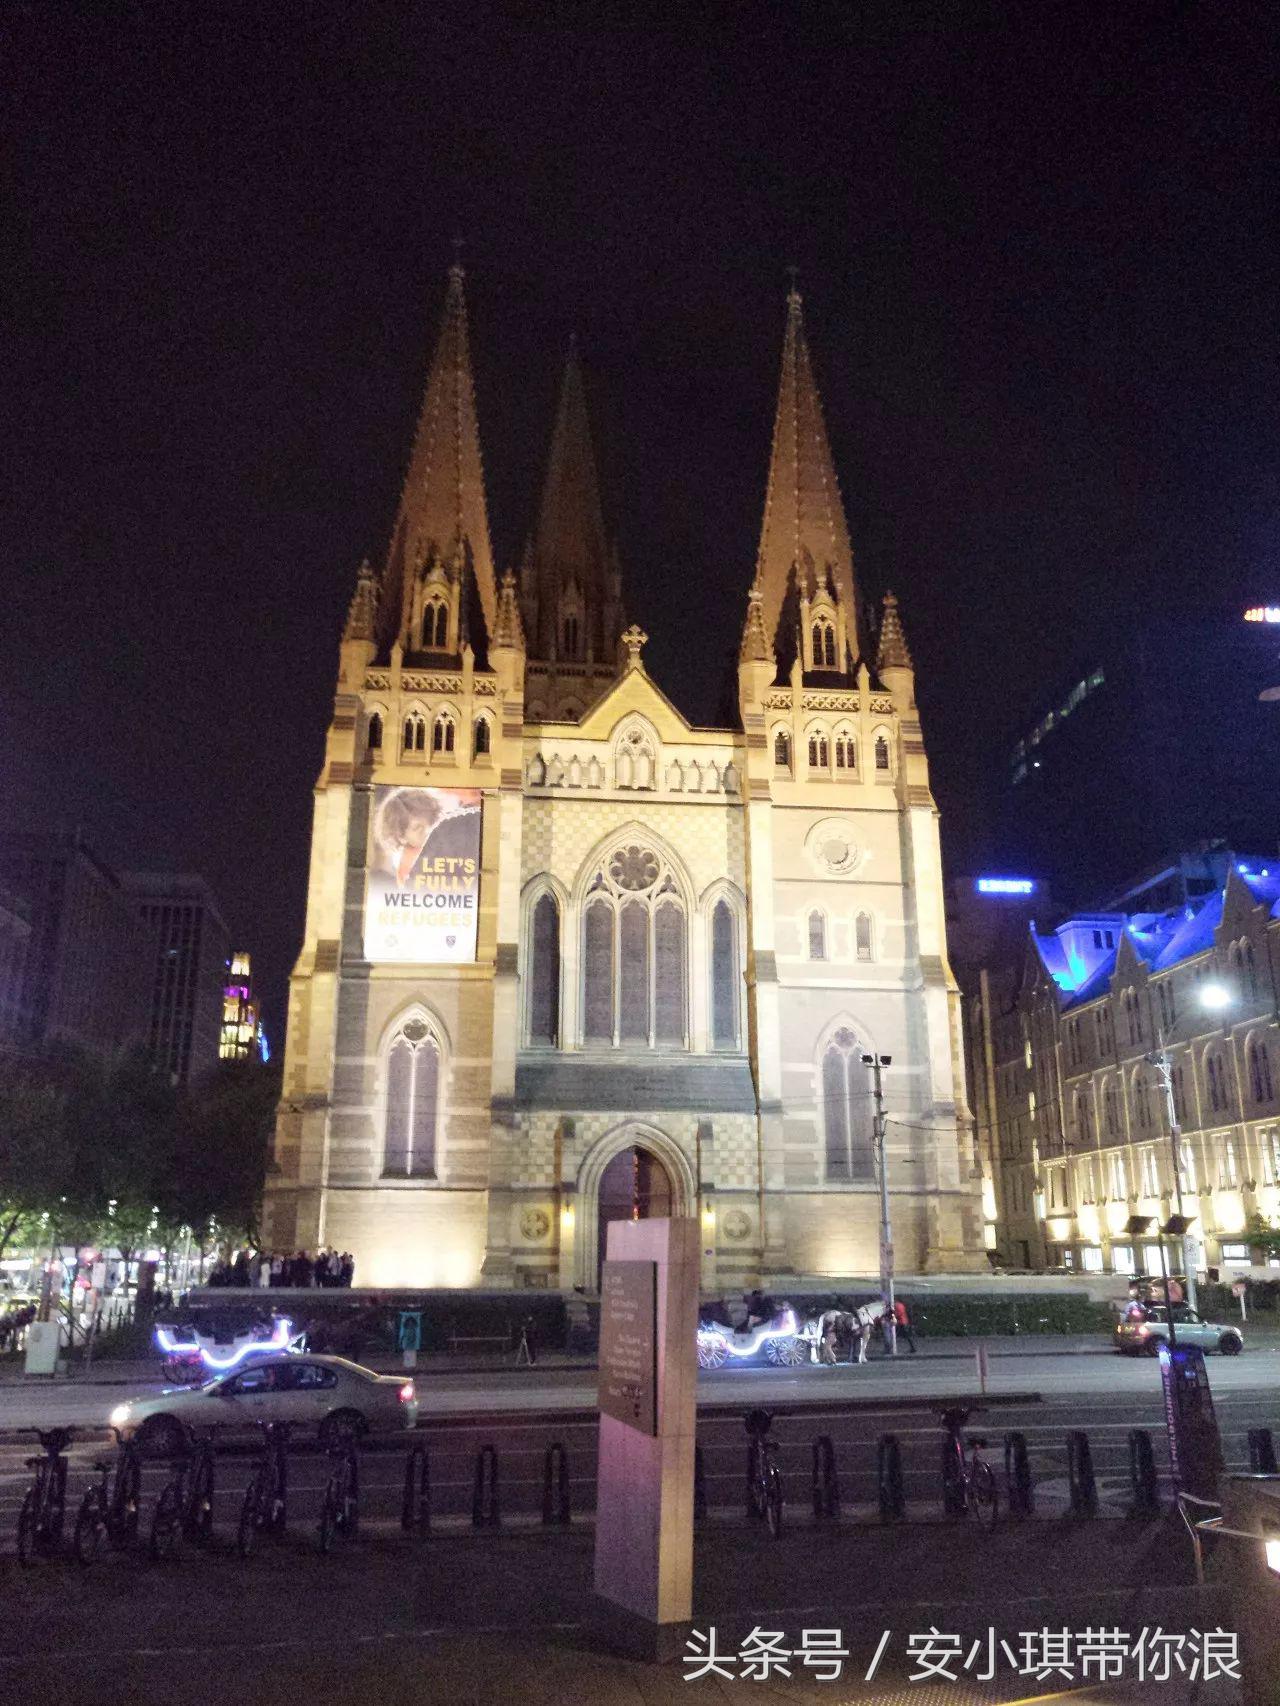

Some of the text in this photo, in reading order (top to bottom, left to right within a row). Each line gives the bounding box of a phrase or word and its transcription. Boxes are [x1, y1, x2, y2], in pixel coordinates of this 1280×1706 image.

[422, 857, 475, 873] LET'S
[415, 875, 475, 892] FULLY
[384, 893, 473, 908] WELCOME
[378, 911, 473, 928] REFUGEES
[1164, 1377, 1178, 1461] MELBOURNE
